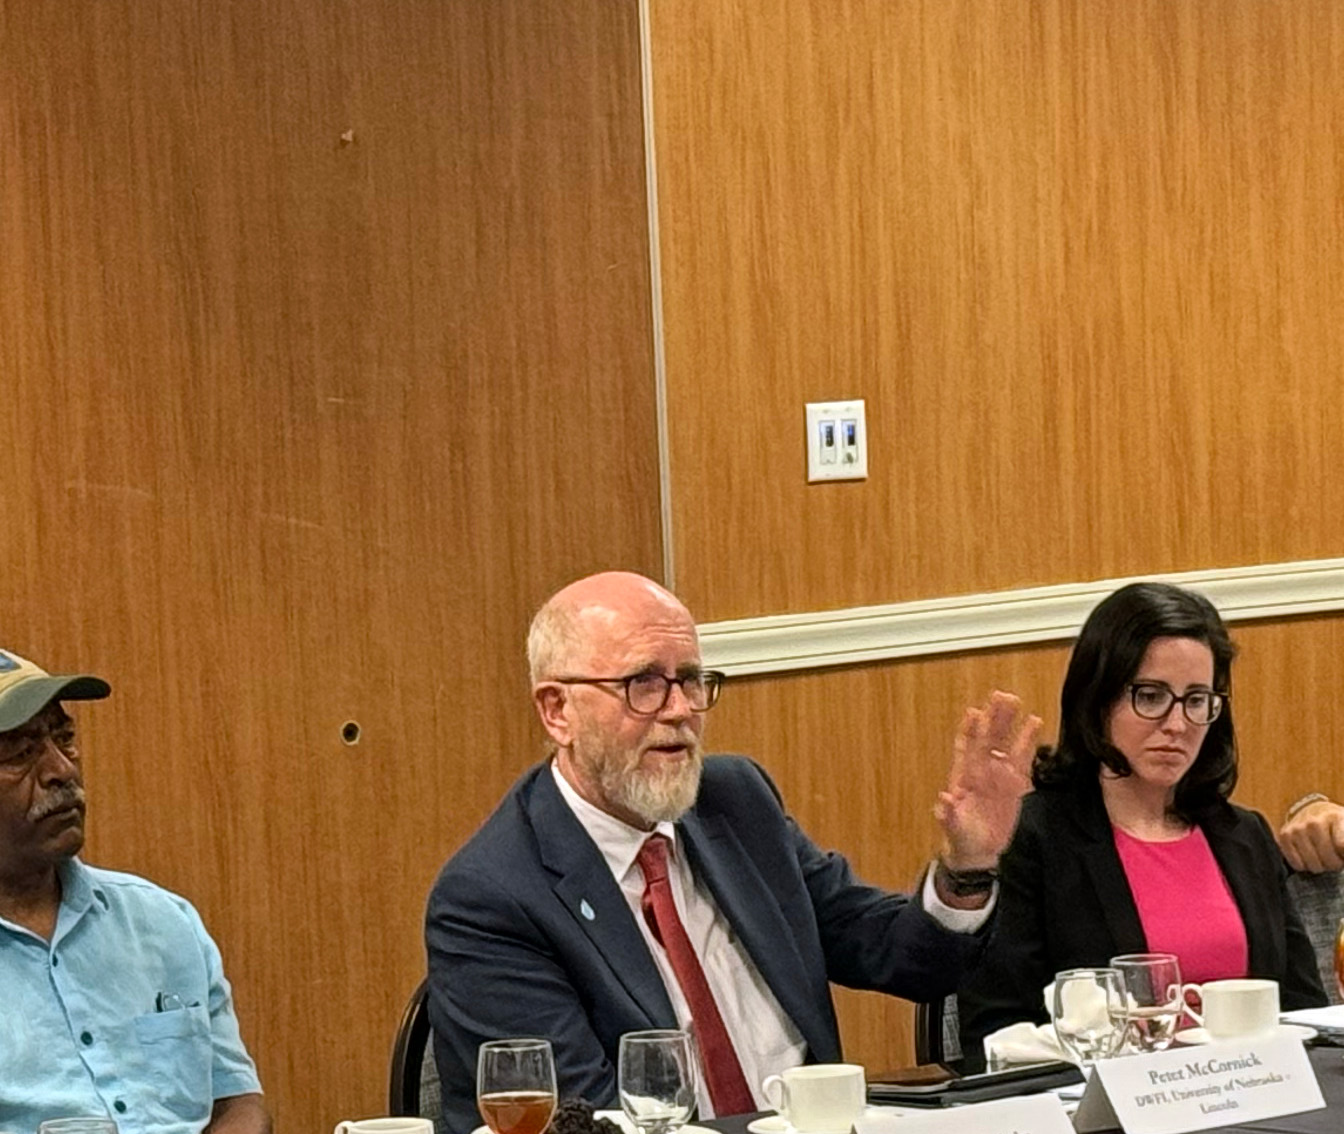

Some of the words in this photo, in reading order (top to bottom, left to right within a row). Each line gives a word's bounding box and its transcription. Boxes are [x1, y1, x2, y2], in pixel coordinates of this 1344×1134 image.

[1147, 1069, 1184, 1085] Peter
[1185, 1053, 1263, 1080] McCornick
[1172, 1084, 1221, 1102] University
[1224, 1078, 1235, 1092] of
[1235, 1072, 1284, 1091] Nebraska
